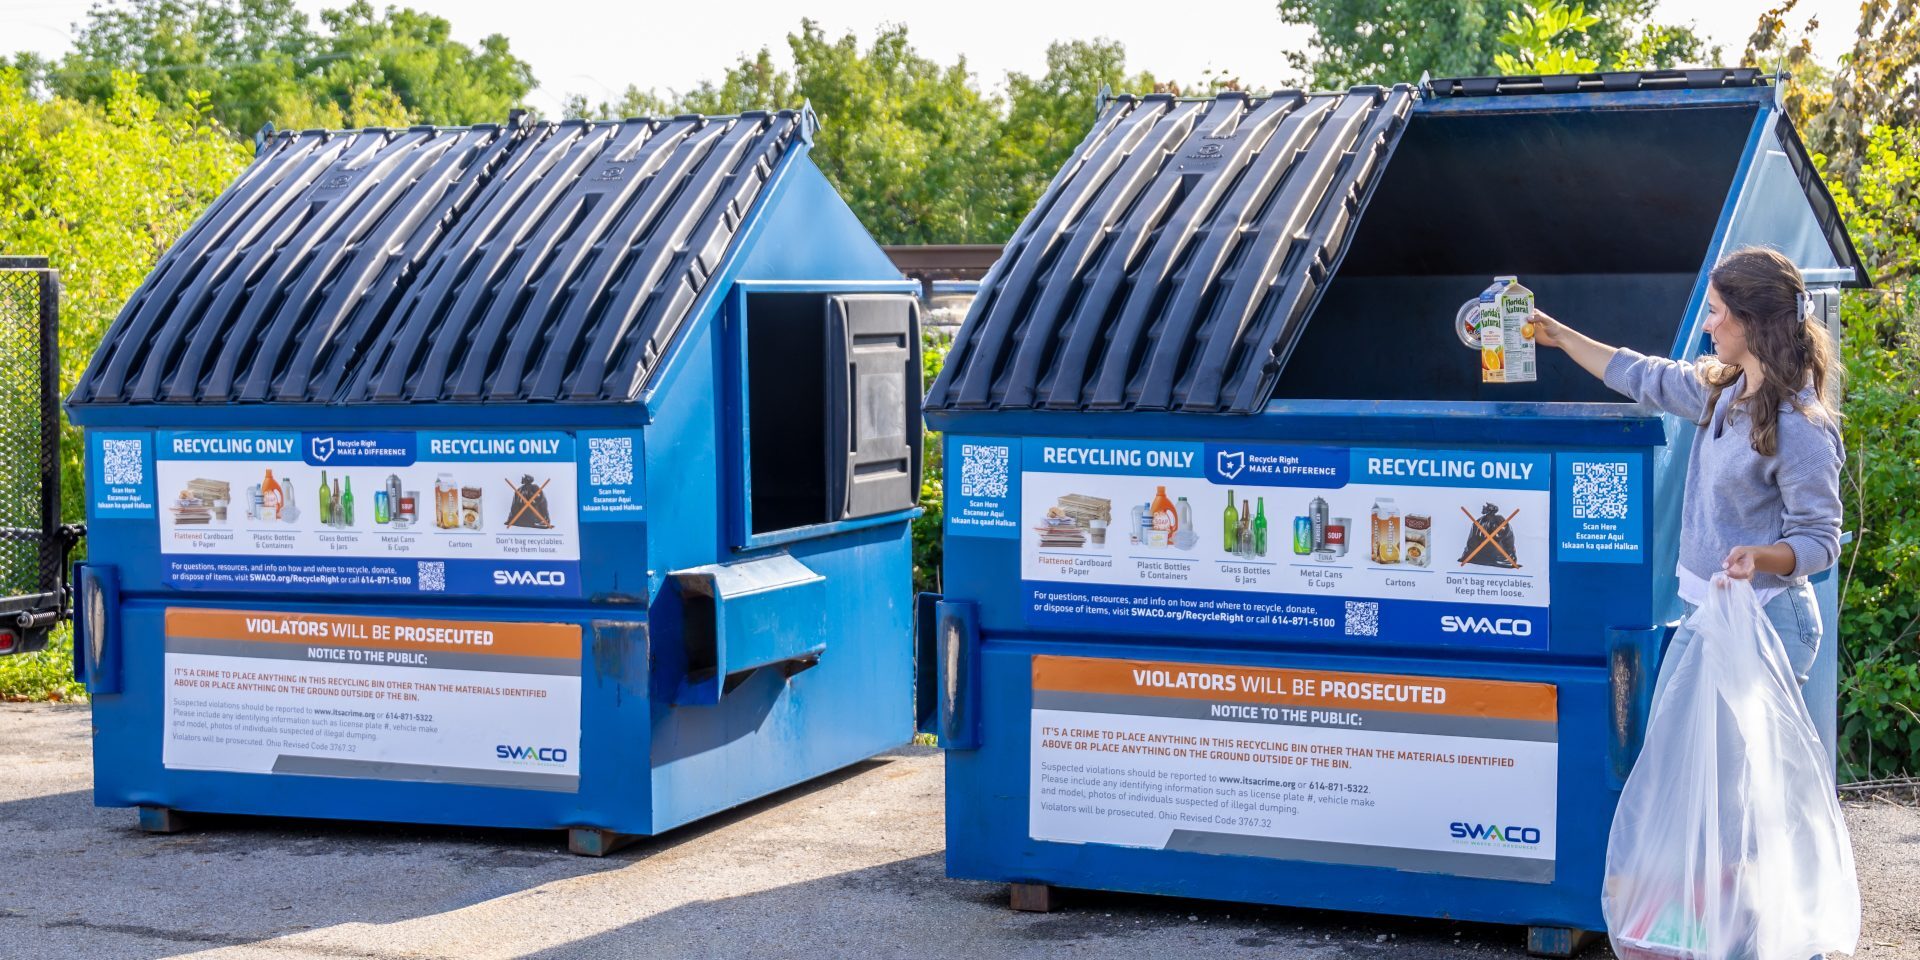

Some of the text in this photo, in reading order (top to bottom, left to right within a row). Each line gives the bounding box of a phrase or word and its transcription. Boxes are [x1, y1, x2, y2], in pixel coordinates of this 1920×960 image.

[173, 439, 294, 453] RECYCLING ONLY
[360, 440, 376, 448] Right
[431, 440, 560, 454] RECYCLING ONLY
[1044, 447, 1194, 468] RECYCLING ONLY
[1249, 455, 1299, 465] Recycle Right
[1249, 465, 1272, 473] MAKE
[1283, 466, 1336, 475] DIFFERENCE
[1368, 458, 1533, 479] RECYCLING ONLY
[514, 538, 526, 547] bag
[1576, 532, 1606, 540] Escanear
[520, 545, 537, 553] them
[1038, 556, 1112, 567] Flattened Cardboard
[1137, 561, 1191, 571] Plastic Bottles
[1068, 567, 1089, 576] Paper
[1140, 570, 1188, 580] & Containers
[1221, 565, 1271, 575] Glass Bottles
[1300, 569, 1343, 579] Metal Cans
[494, 571, 565, 585] SWACO
[1235, 575, 1257, 584] & Jars
[1308, 579, 1335, 589] & Cups
[1385, 578, 1416, 587] Cartons
[1446, 576, 1534, 588] Don't bag recyclables.
[1455, 587, 1475, 596] Keep
[1477, 587, 1498, 596] them
[1034, 591, 1047, 599] For
[1048, 593, 1089, 602] questions,
[1091, 596, 1131, 604] resources,
[1133, 597, 1148, 605] and
[1150, 597, 1166, 606] info
[1180, 598, 1197, 607] how
[1199, 600, 1214, 608] and
[1216, 601, 1241, 610] where
[1243, 603, 1252, 611] to
[1254, 604, 1284, 613] recycle,
[1286, 605, 1318, 614] donate,
[1044, 603, 1074, 613] dispose
[1075, 605, 1084, 613] of
[1086, 606, 1110, 615] items,
[1112, 608, 1129, 616] visit
[1131, 608, 1244, 623] SWACO.org/RecycleRight
[1256, 615, 1270, 623] call
[1272, 616, 1335, 627] 614-871-5100
[246, 618, 493, 645] VIOLATORS WILL BE PROSECUTED
[1441, 616, 1531, 636] SWACO
[308, 648, 428, 664] NOTICE TO THE PUBLIC:
[1133, 670, 1446, 703] VIOLATORS WILL BE PROSECUTED
[1211, 705, 1362, 725] NOTICE TO THE PUBLIC:
[496, 745, 567, 762] SWACO
[1042, 727, 1514, 767] IT'S A CRIME TO PLACE ANYTHING IN THIS RECYCLING BIN OTHER THAN THE MATERIALS IDENTIFIED
[1042, 740, 1352, 768] ABOVE OR PLACE ANYTHING ON THE GROUND OUTSIDE OF THE BIN.
[1041, 762, 1084, 773] Suspected
[1086, 766, 1125, 776] violations
[1127, 768, 1156, 778] should
[1158, 770, 1168, 779] be
[1170, 773, 1206, 782] reported
[1219, 775, 1295, 790] www.itsacrime.org
[1040, 802, 1077, 812] Violators
[1078, 806, 1093, 814] will
[1095, 806, 1105, 815] be
[1158, 811, 1178, 820] Ohio
[1180, 812, 1213, 823] Revised
[1215, 815, 1236, 825] Code
[1238, 817, 1272, 828] 3767.32
[1450, 822, 1540, 843] SWACO
